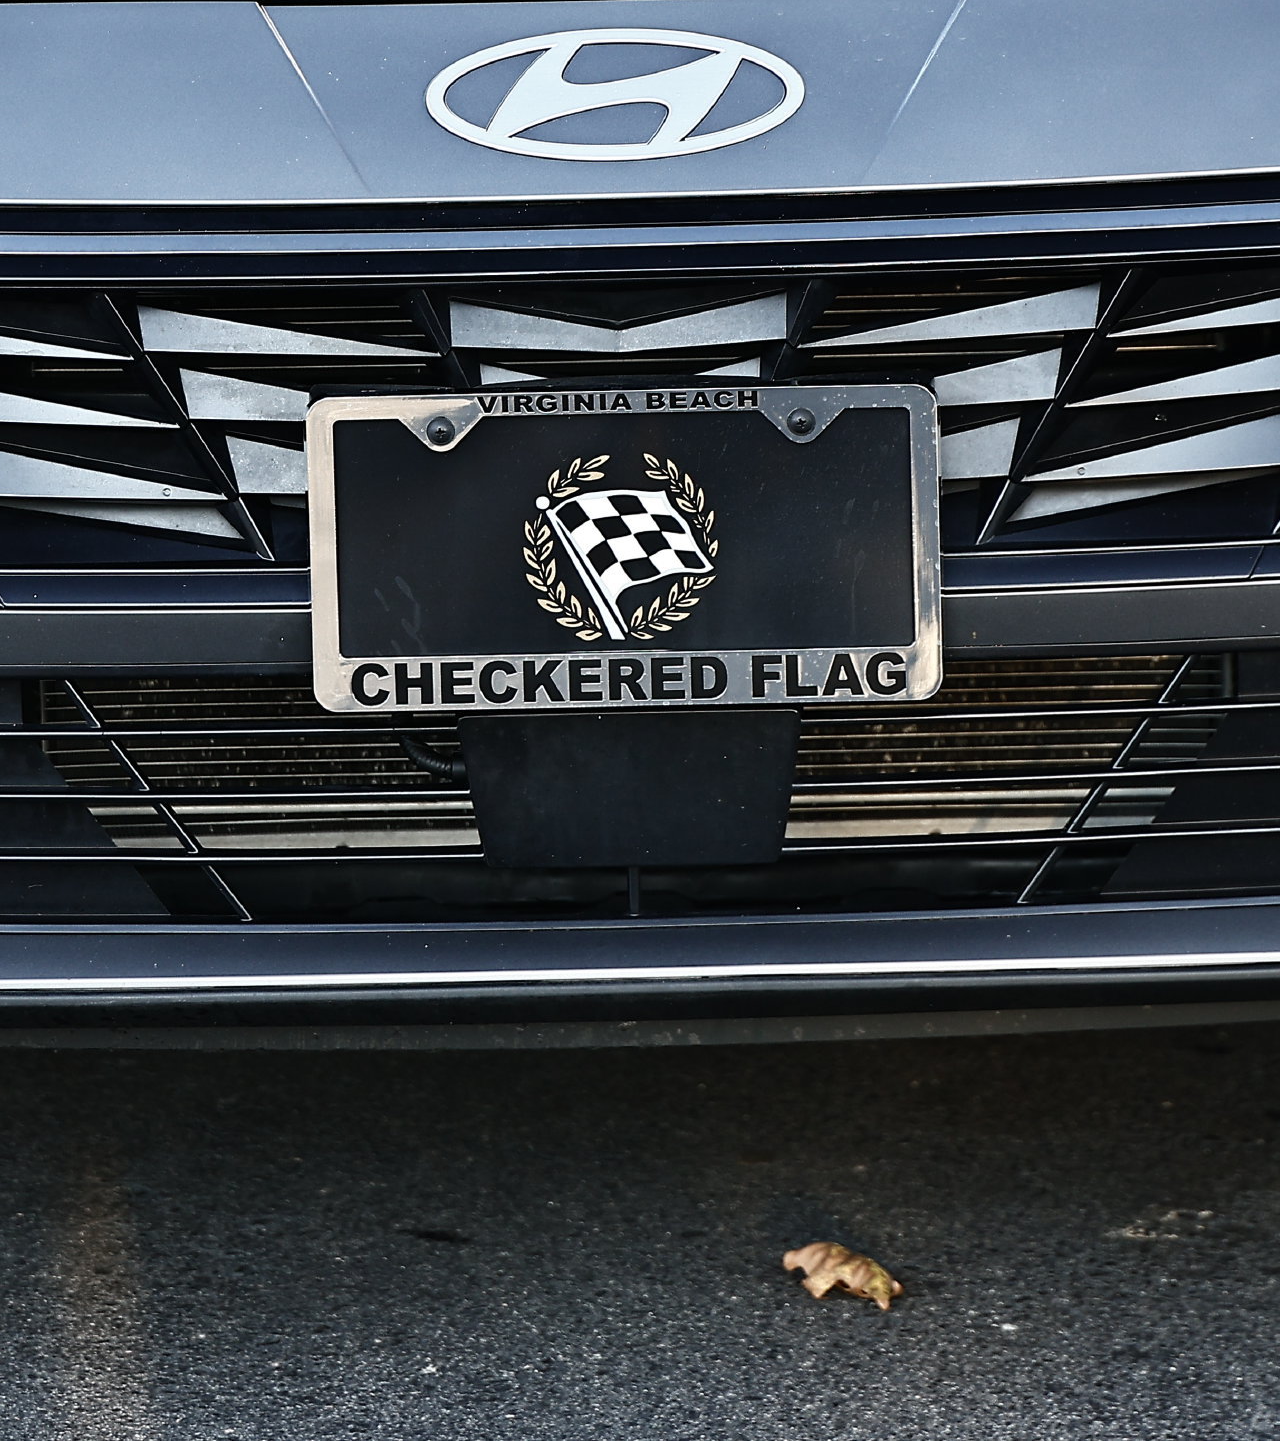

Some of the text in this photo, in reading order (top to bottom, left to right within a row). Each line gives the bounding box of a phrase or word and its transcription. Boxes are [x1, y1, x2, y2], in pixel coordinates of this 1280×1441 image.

[477, 390, 759, 414] VIRGINIA BEACH
[350, 652, 908, 706] CHECKERED FLAG
